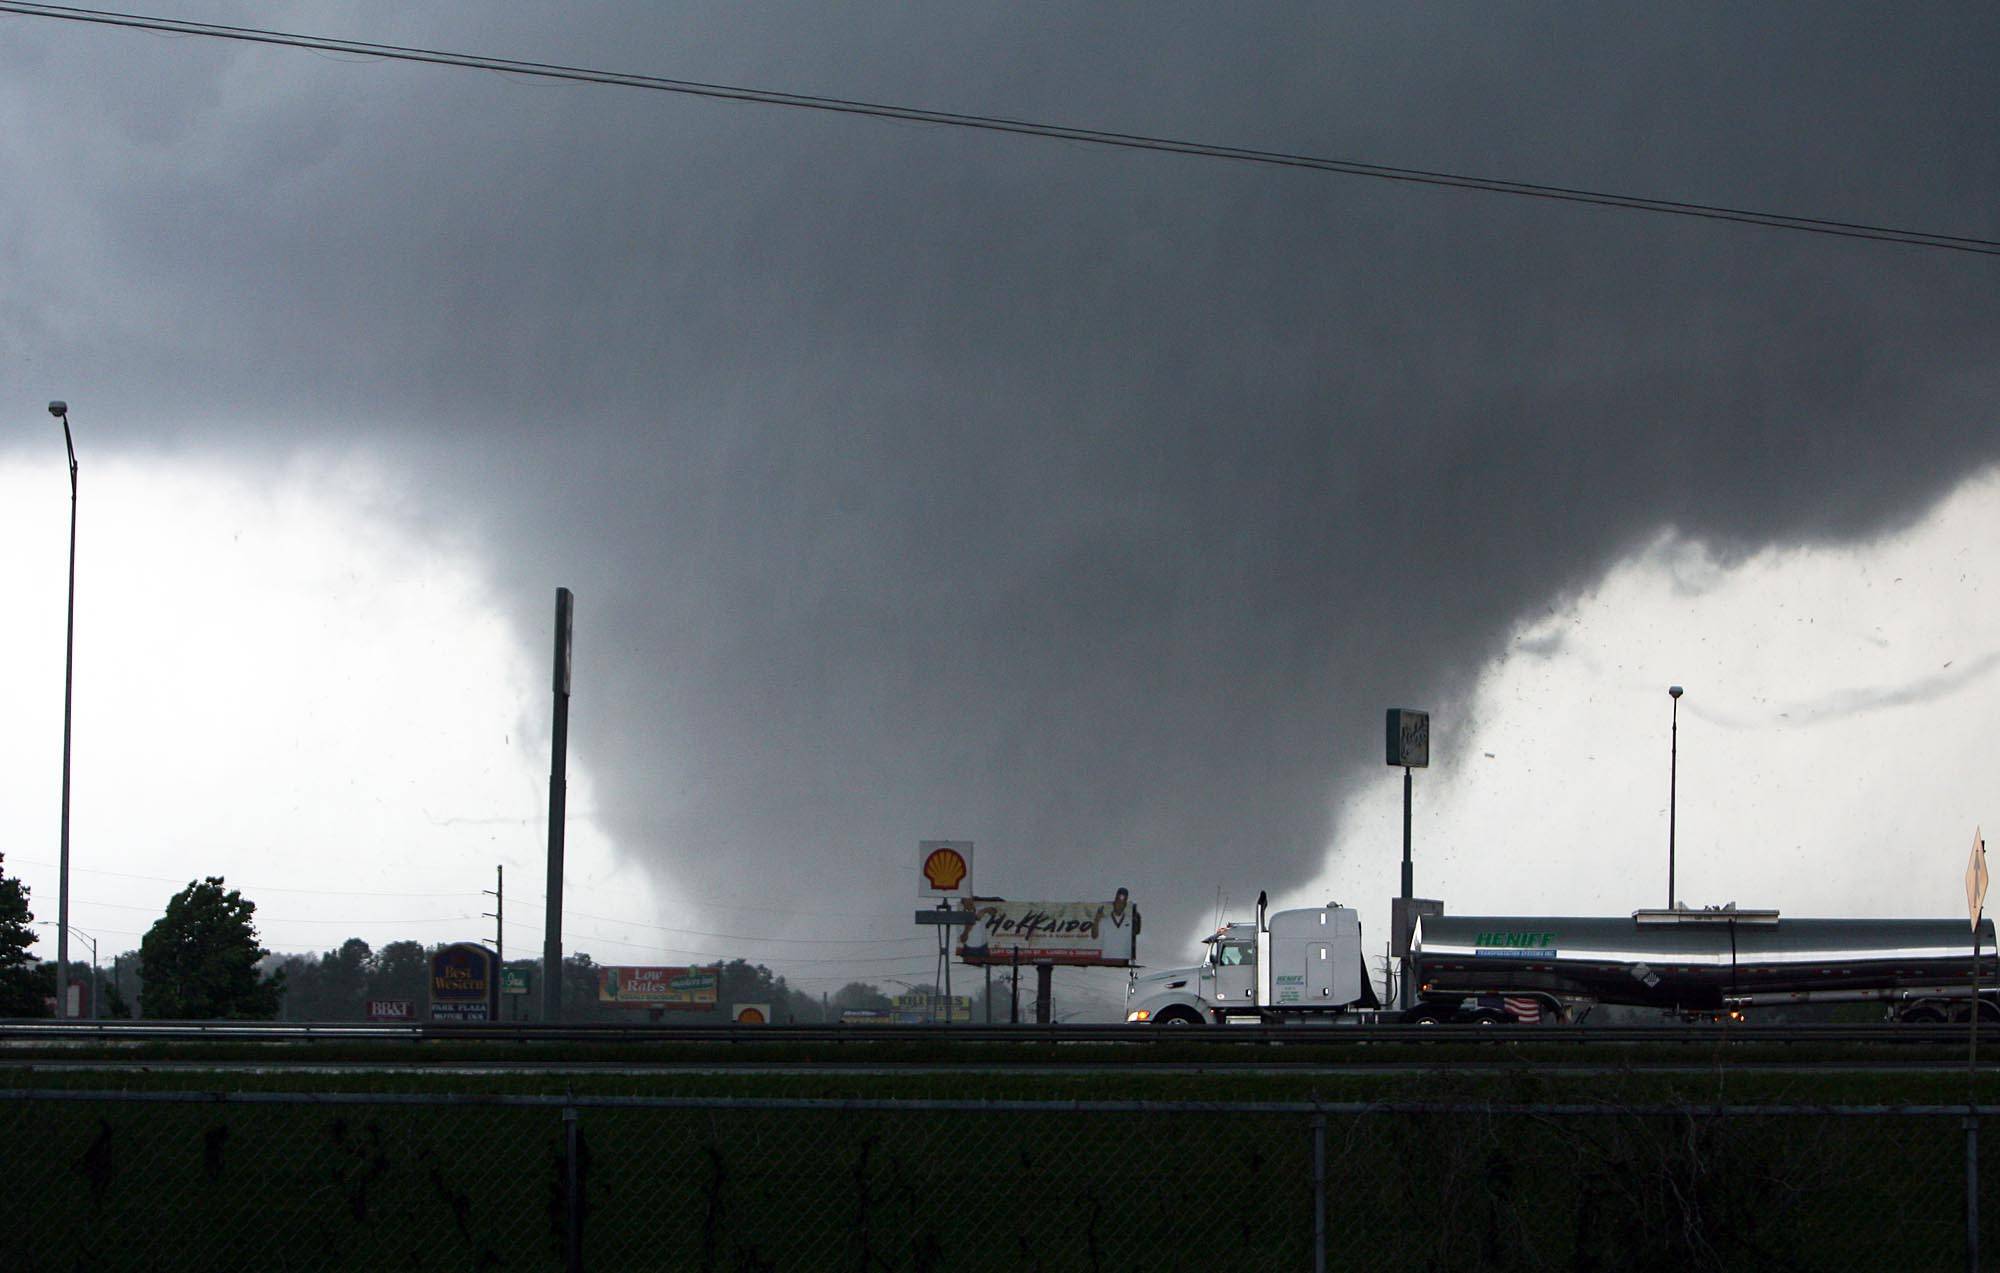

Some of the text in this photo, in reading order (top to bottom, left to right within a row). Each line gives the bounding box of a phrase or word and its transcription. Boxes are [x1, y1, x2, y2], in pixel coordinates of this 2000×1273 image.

[1476, 932, 1555, 947] HENIFF
[446, 966, 471, 978] Best
[635, 968, 663, 980] Low
[435, 976, 485, 990] Western
[627, 980, 667, 993] Rates
[373, 1001, 408, 1015] BB&T
